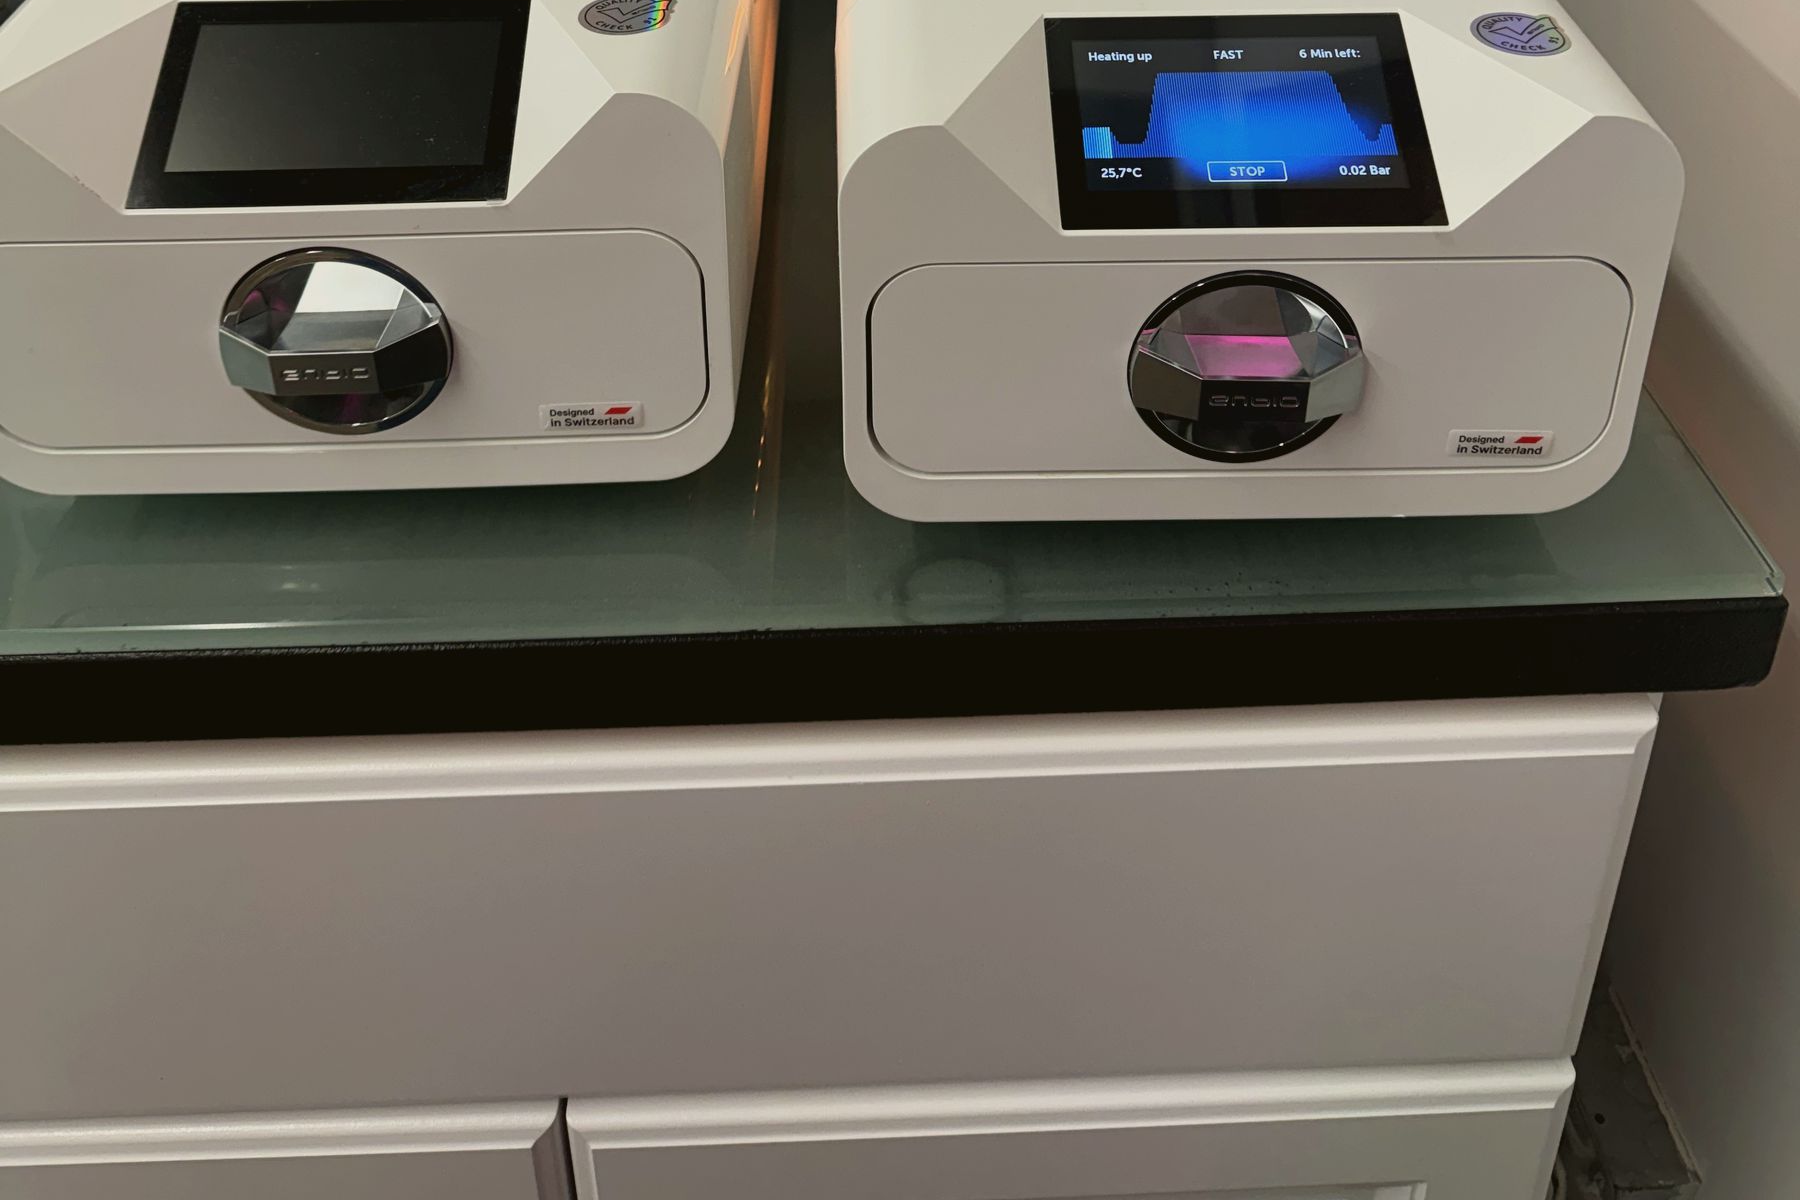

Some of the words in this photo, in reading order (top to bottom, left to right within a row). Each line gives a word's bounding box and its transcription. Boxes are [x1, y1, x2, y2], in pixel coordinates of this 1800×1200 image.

[595, 21, 633, 31] CHECK
[1482, 16, 1522, 30] QUALITY
[1500, 41, 1547, 51] CHECK
[1088, 51, 1134, 63] Heating
[1136, 53, 1153, 64] up
[1213, 49, 1244, 60] FAST
[1299, 48, 1307, 59] 6
[1310, 48, 1332, 58] Min
[1334, 47, 1361, 59] left:
[1100, 166, 1143, 179] 25,7°C
[1229, 165, 1266, 177] STOP
[1339, 164, 1367, 176] 0.02
[1369, 164, 1391, 176] Bar
[549, 408, 595, 418] Designed
[550, 418, 562, 427] in
[564, 416, 635, 427] Switzerland
[1458, 435, 1505, 444] Designed
[1456, 444, 1468, 454] in
[1471, 445, 1543, 455] Switzerland
